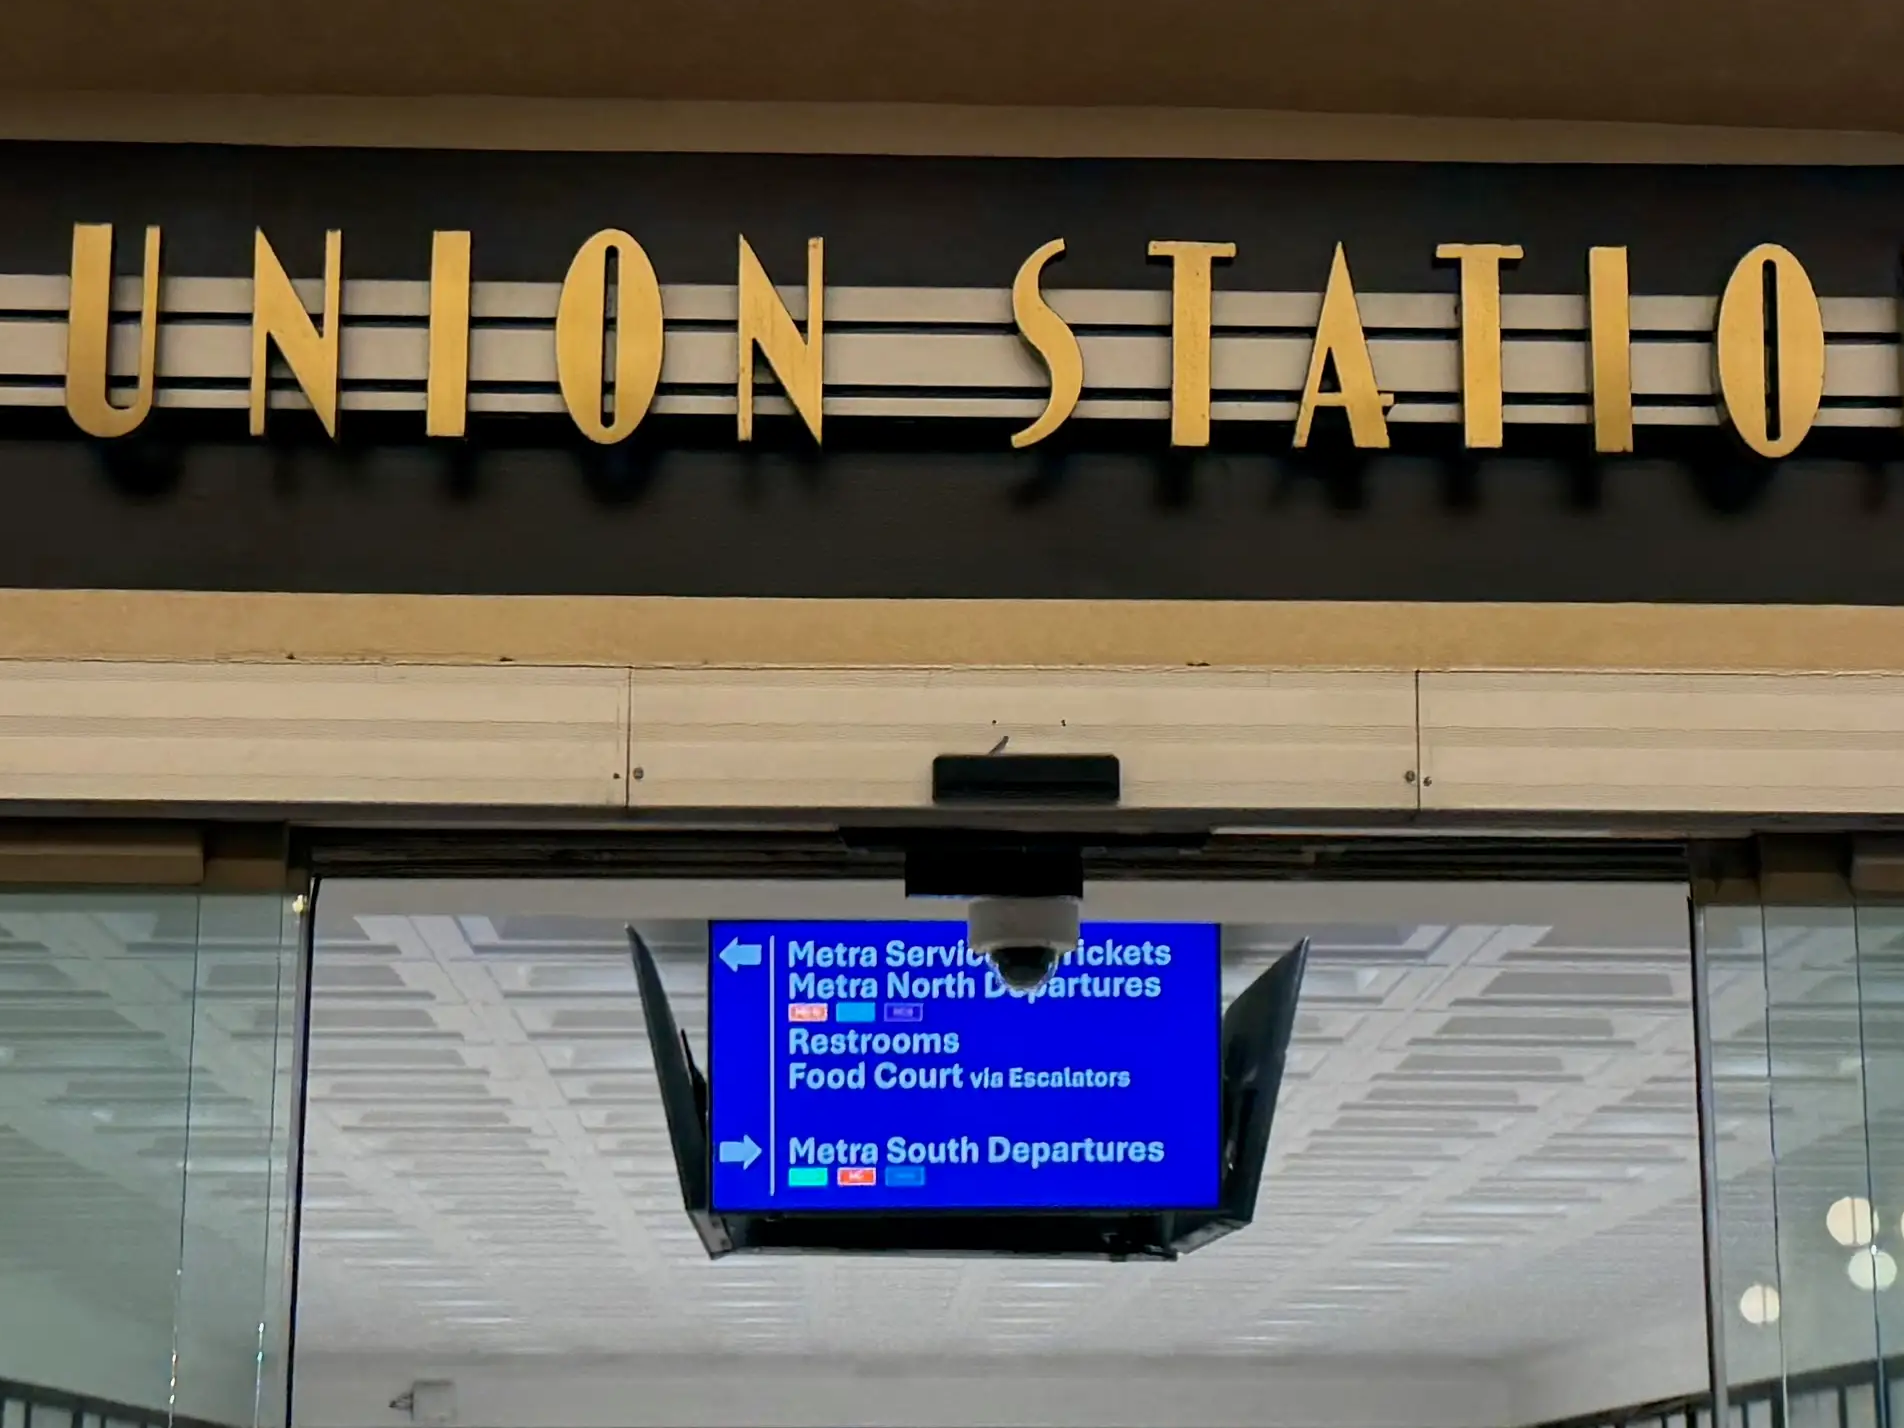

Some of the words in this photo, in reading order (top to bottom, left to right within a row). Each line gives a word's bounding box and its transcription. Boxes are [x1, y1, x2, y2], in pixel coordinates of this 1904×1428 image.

[64, 222, 825, 446] UNION
[788, 940, 878, 968] Metra
[788, 971, 878, 999] Metra
[887, 970, 976, 999] North
[788, 1027, 960, 1055] Restrooms
[789, 1061, 866, 1090] Food
[873, 1061, 964, 1090] Court
[969, 1066, 1004, 1089] via
[1008, 1066, 1131, 1089] Escalators
[789, 1136, 879, 1165] Metra
[886, 1135, 979, 1165] South
[987, 1136, 1165, 1170] Departures
